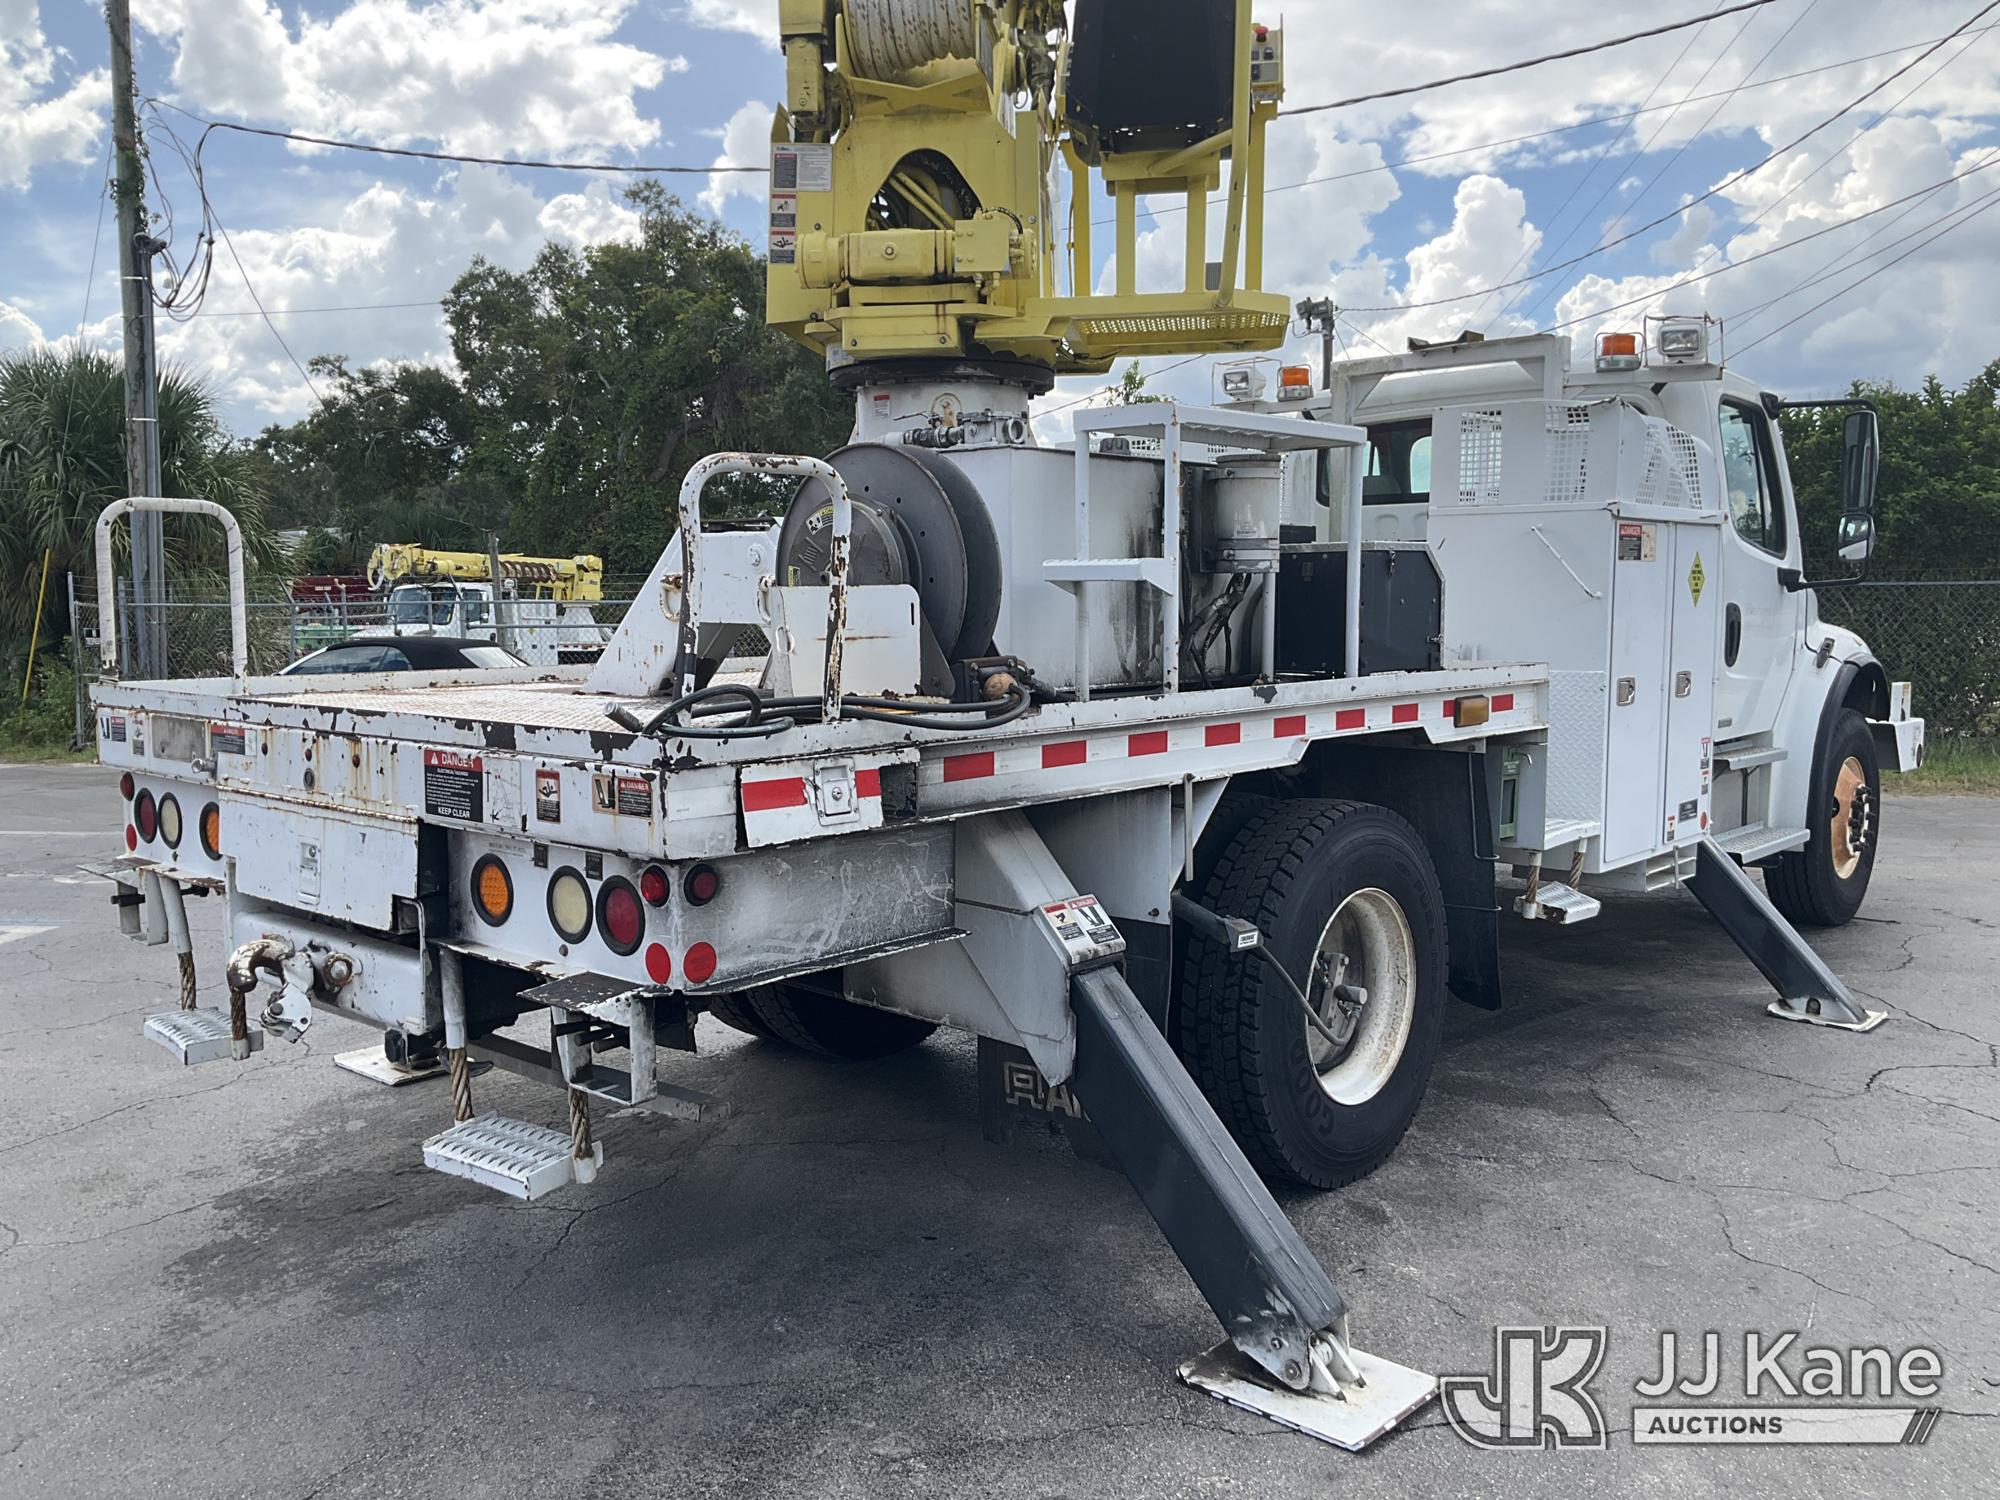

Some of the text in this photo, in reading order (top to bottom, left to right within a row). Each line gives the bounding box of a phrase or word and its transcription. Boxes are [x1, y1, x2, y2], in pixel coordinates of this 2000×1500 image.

[442, 753, 474, 768] DANGER
[438, 806, 470, 819] KEEP CLEAR
